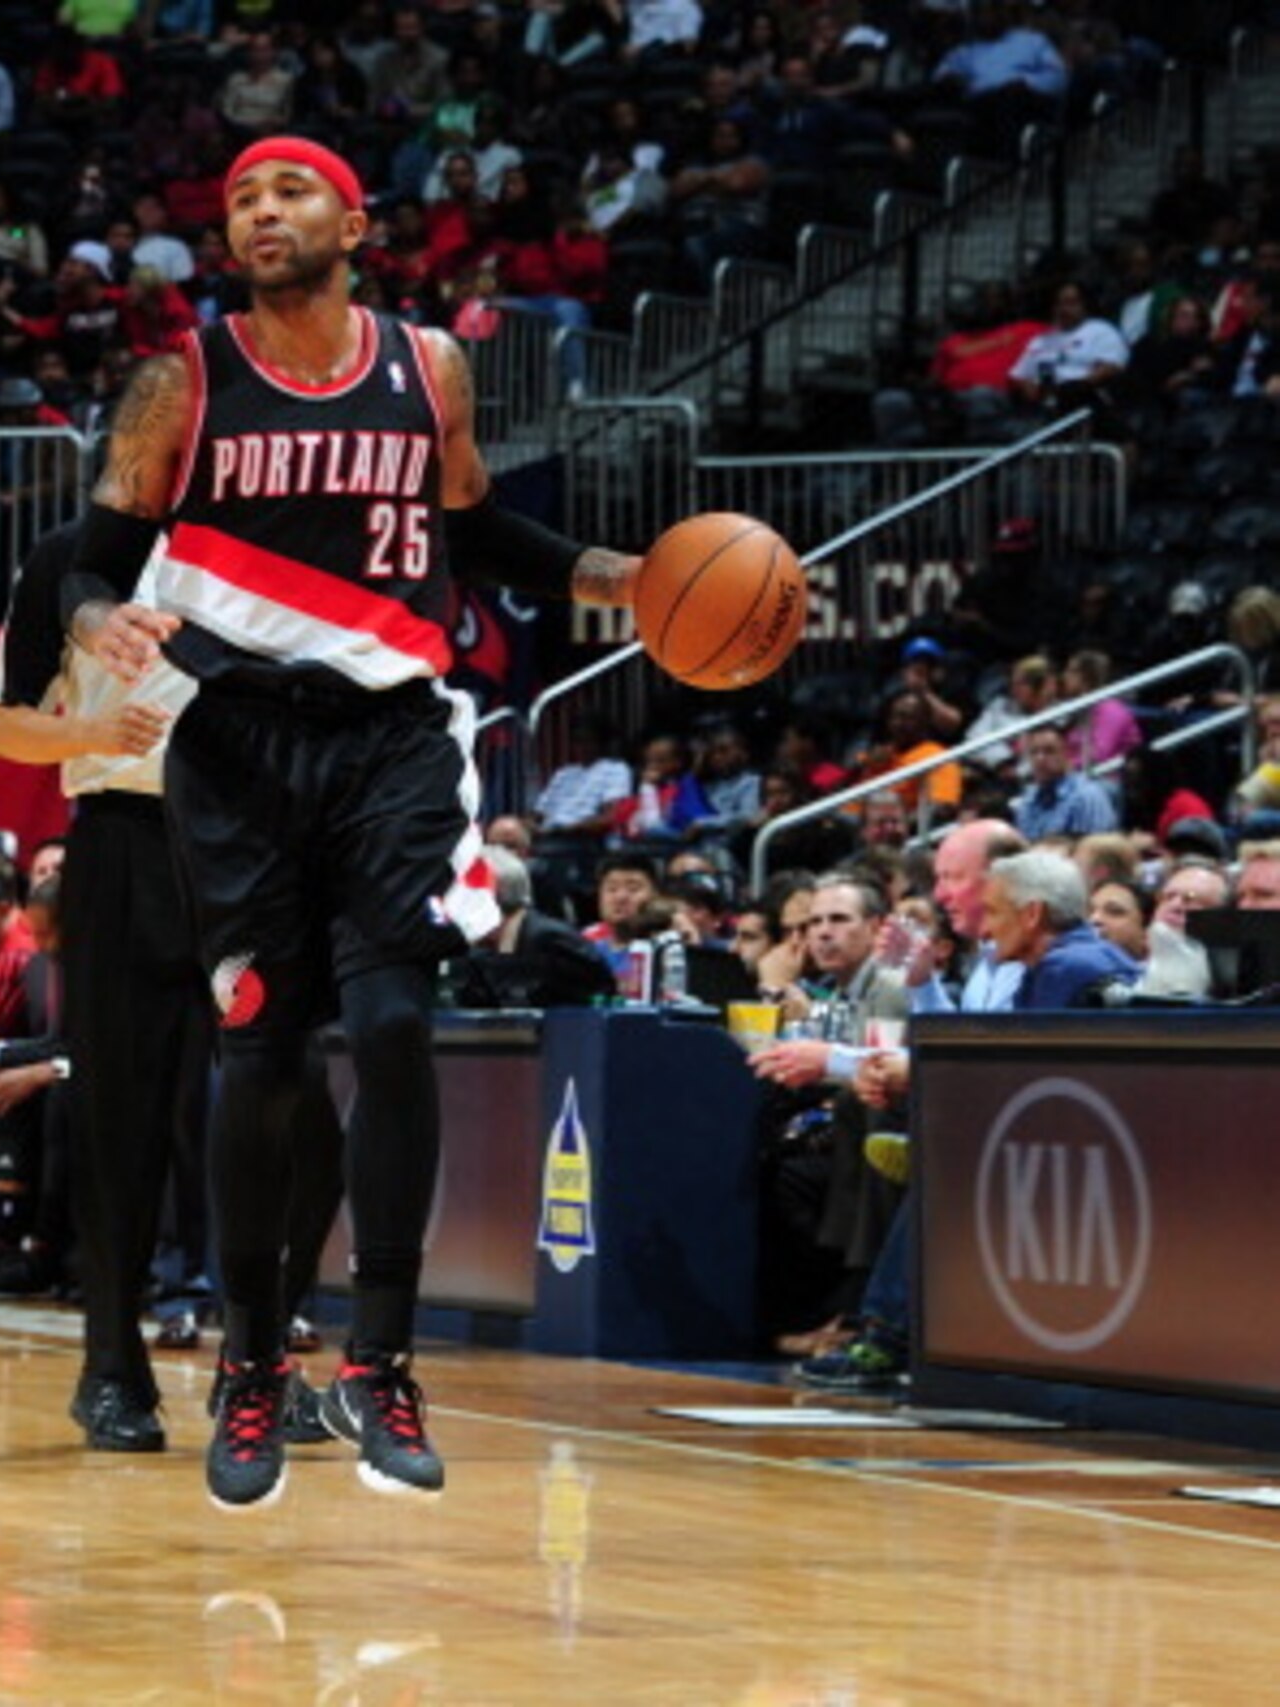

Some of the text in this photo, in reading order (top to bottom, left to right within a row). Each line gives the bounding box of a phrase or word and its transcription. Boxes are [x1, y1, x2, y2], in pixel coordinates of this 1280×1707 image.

[213, 432, 431, 500] PORTLAND
[365, 502, 430, 578] 25
[1004, 1142, 1120, 1288] KIA
